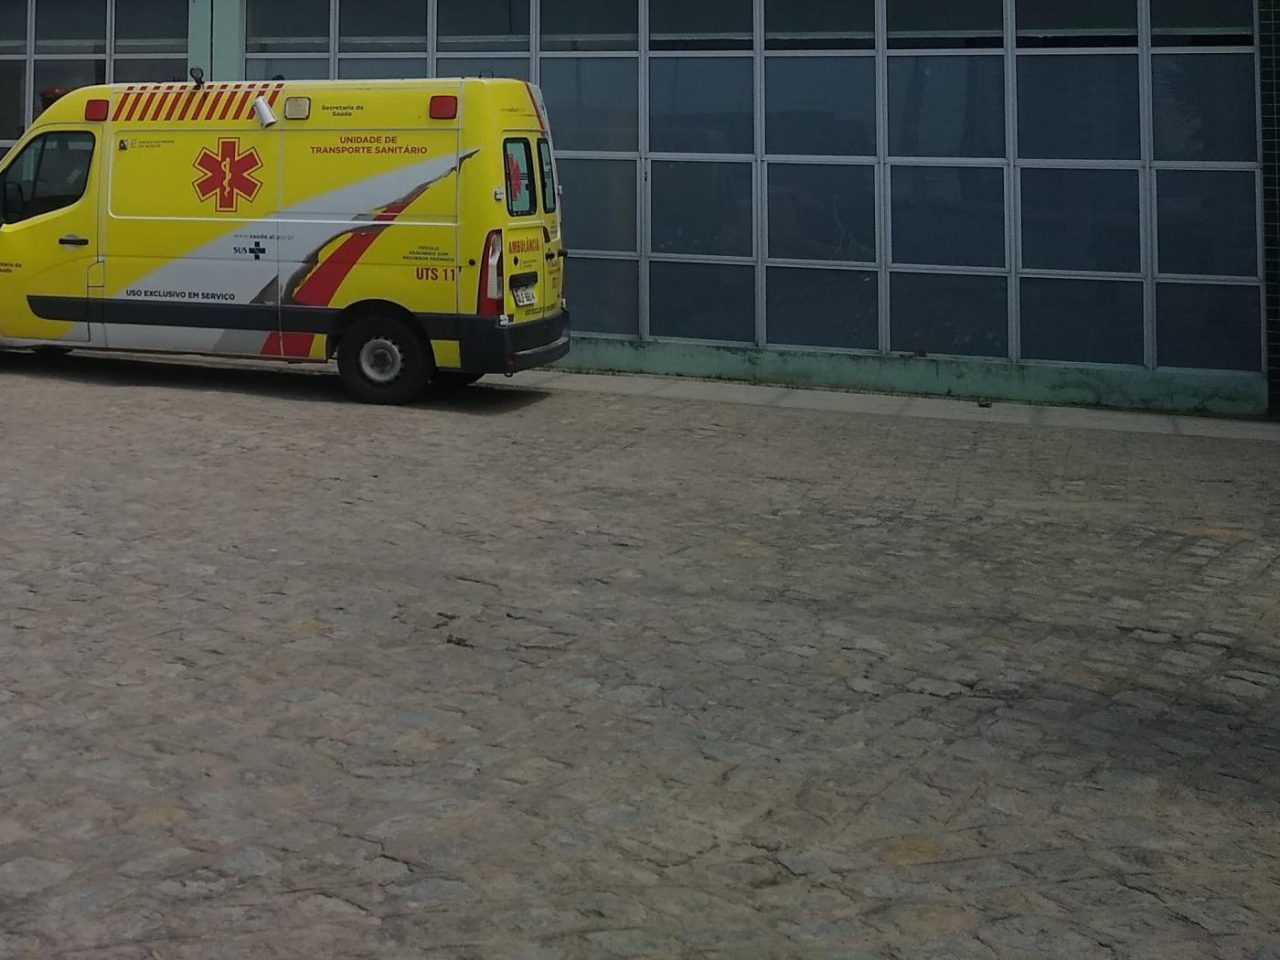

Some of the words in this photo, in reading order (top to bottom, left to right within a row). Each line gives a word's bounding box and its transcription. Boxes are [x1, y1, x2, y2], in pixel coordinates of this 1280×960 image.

[339, 136, 383, 144] UNIDADE
[384, 136, 398, 144] DE
[310, 146, 373, 154] TRANSPORTE
[374, 144, 428, 154] SANITÁRIO
[232, 246, 249, 254] SUS
[416, 266, 439, 281] UTS
[126, 289, 143, 297] USO
[143, 290, 187, 299] EXCLUSIVO
[201, 292, 236, 301] SERVIÇO
